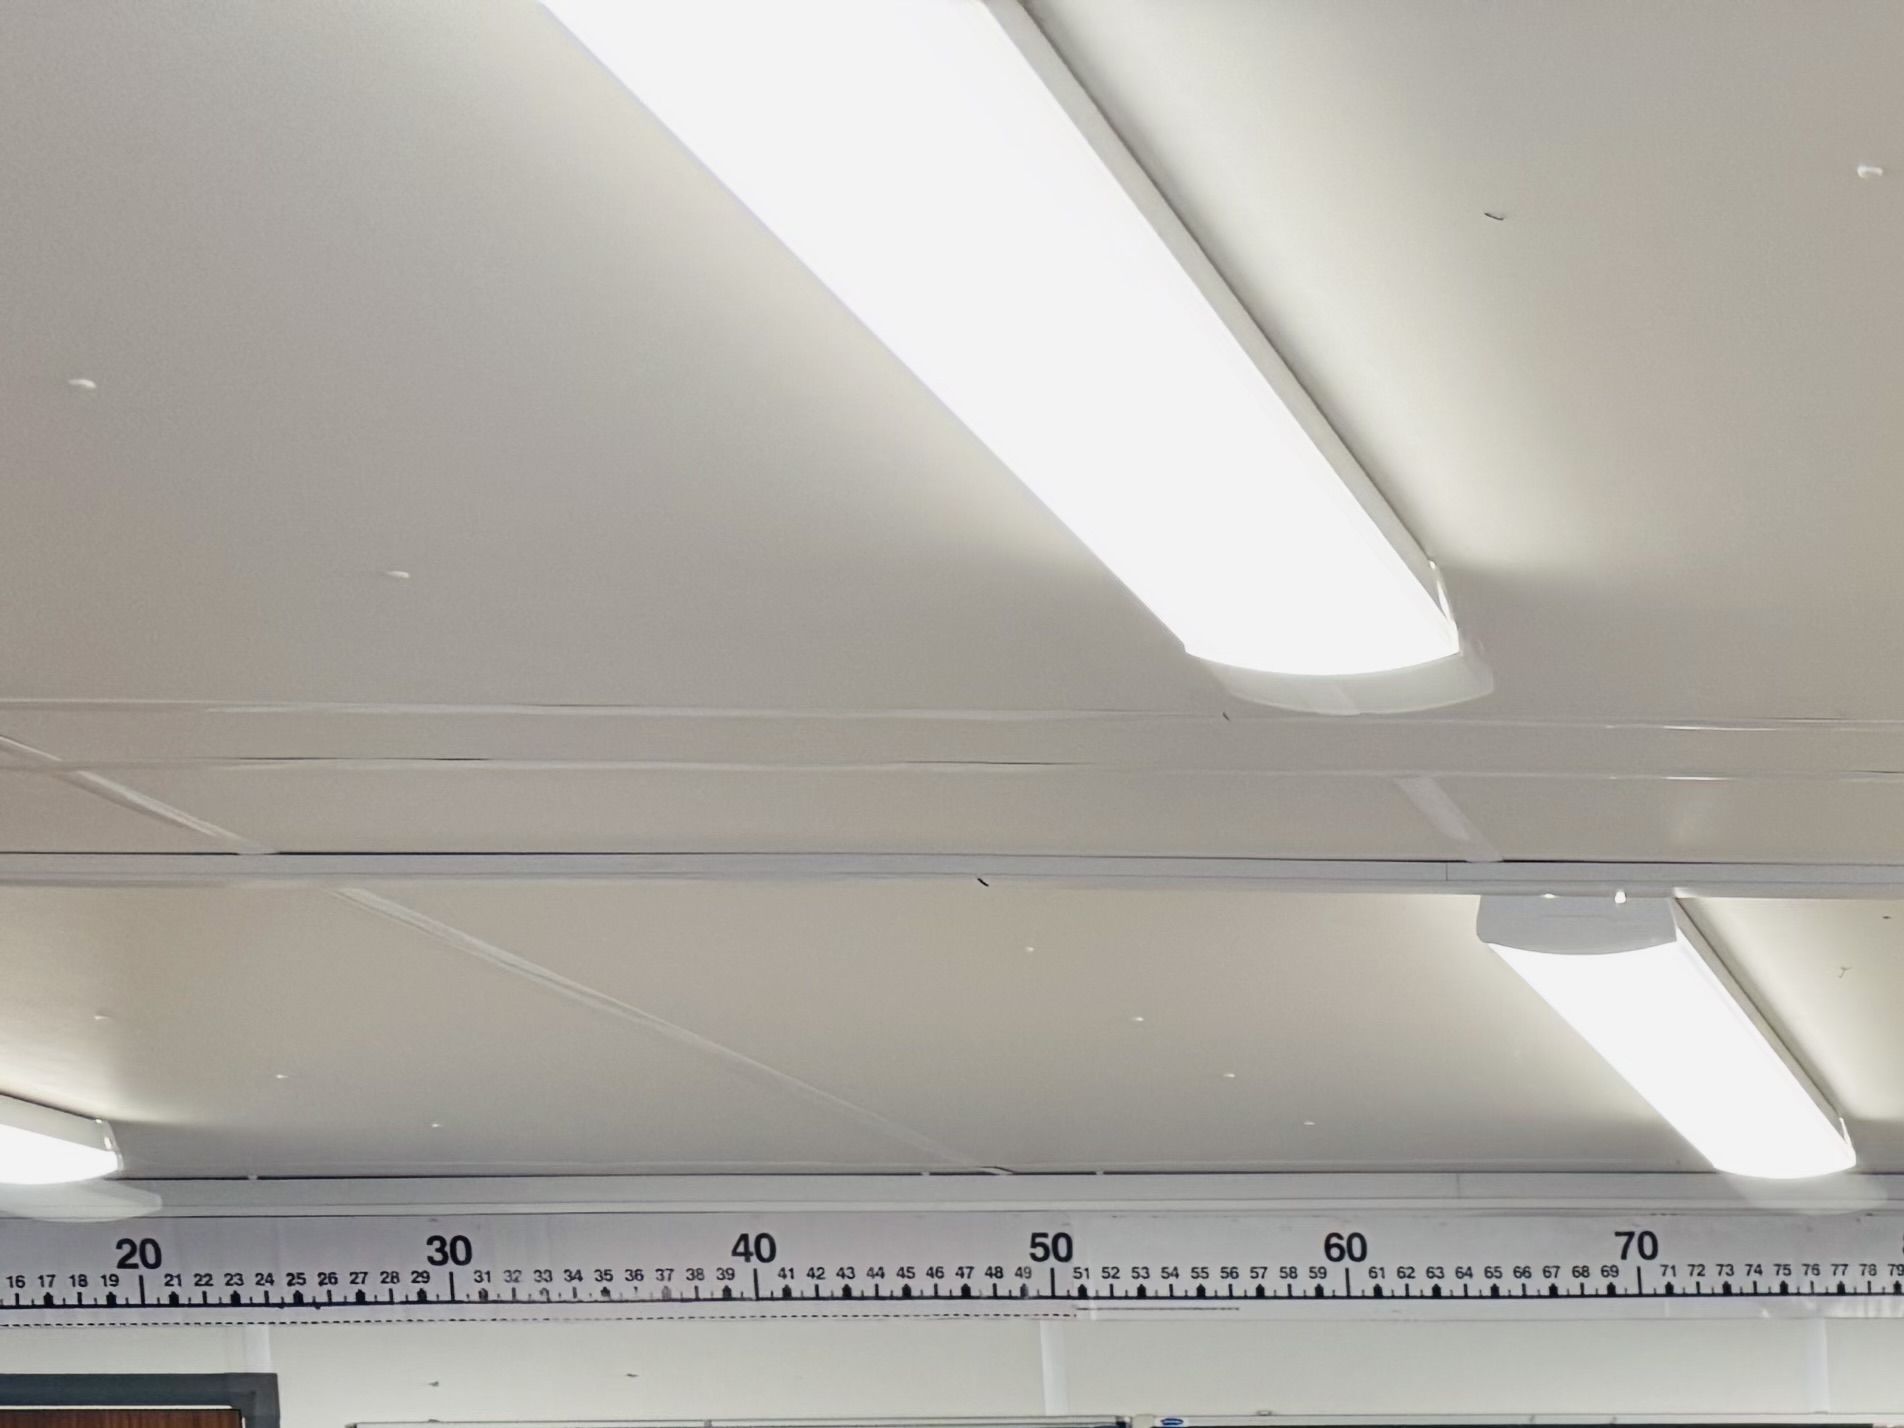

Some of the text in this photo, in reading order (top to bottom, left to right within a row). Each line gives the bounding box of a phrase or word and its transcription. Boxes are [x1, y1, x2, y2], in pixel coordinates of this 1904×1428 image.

[116, 1239, 161, 1269] 20
[427, 1235, 472, 1266] 30
[732, 1233, 776, 1262] 40
[1030, 1233, 1072, 1262] 50
[1325, 1233, 1367, 1262] 60
[1615, 1231, 1658, 1260] 70
[6, 1274, 26, 1289] 16
[37, 1273, 57, 1288] 17
[68, 1273, 89, 1288] 18
[100, 1273, 120, 1288] 19
[163, 1272, 182, 1287] 21
[193, 1272, 214, 1287] 22
[223, 1272, 245, 1287] 23
[254, 1272, 275, 1287] 24
[285, 1272, 307, 1287] 25
[317, 1271, 339, 1287] 26
[349, 1271, 369, 1285] 27
[379, 1270, 401, 1285] 28
[410, 1269, 431, 1284] 29
[473, 1269, 491, 1284] 31
[503, 1269, 523, 1284] 32
[533, 1268, 553, 1283] 33
[563, 1268, 584, 1283] 34
[593, 1268, 614, 1283] 35
[624, 1268, 645, 1282] 36
[654, 1267, 675, 1282] 37
[685, 1267, 705, 1282] 38
[716, 1267, 736, 1281] 39
[777, 1266, 795, 1280] 41
[806, 1266, 826, 1281] 42
[835, 1266, 856, 1280] 43
[866, 1266, 886, 1280] 44
[896, 1266, 916, 1280] 45
[925, 1265, 945, 1280] 46
[954, 1265, 975, 1280] 47
[984, 1265, 1004, 1280] 48
[1014, 1266, 1033, 1280] 49
[1072, 1266, 1090, 1280] 51
[1101, 1266, 1121, 1280] 52
[1131, 1266, 1151, 1280] 53
[1160, 1266, 1180, 1280] 54
[1190, 1266, 1210, 1280] 55
[1220, 1266, 1240, 1280] 56
[1249, 1266, 1268, 1280] 57
[1279, 1265, 1298, 1280] 58
[1308, 1266, 1328, 1280] 59
[1368, 1265, 1386, 1280] 61
[1396, 1265, 1416, 1280] 62
[1425, 1266, 1445, 1280] 63
[1454, 1265, 1474, 1280] 64
[1483, 1265, 1503, 1280] 65
[1512, 1265, 1533, 1279] 66
[1542, 1265, 1561, 1279] 67
[1571, 1264, 1591, 1279] 68
[1600, 1264, 1620, 1278] 69
[1659, 1263, 1677, 1278] 71
[1687, 1263, 1706, 1277] 72
[1715, 1263, 1735, 1277] 73
[1744, 1263, 1763, 1277] 74
[1773, 1263, 1792, 1277] 75
[1801, 1263, 1821, 1277] 76
[1830, 1263, 1849, 1277] 77
[1858, 1263, 1878, 1277] 78
